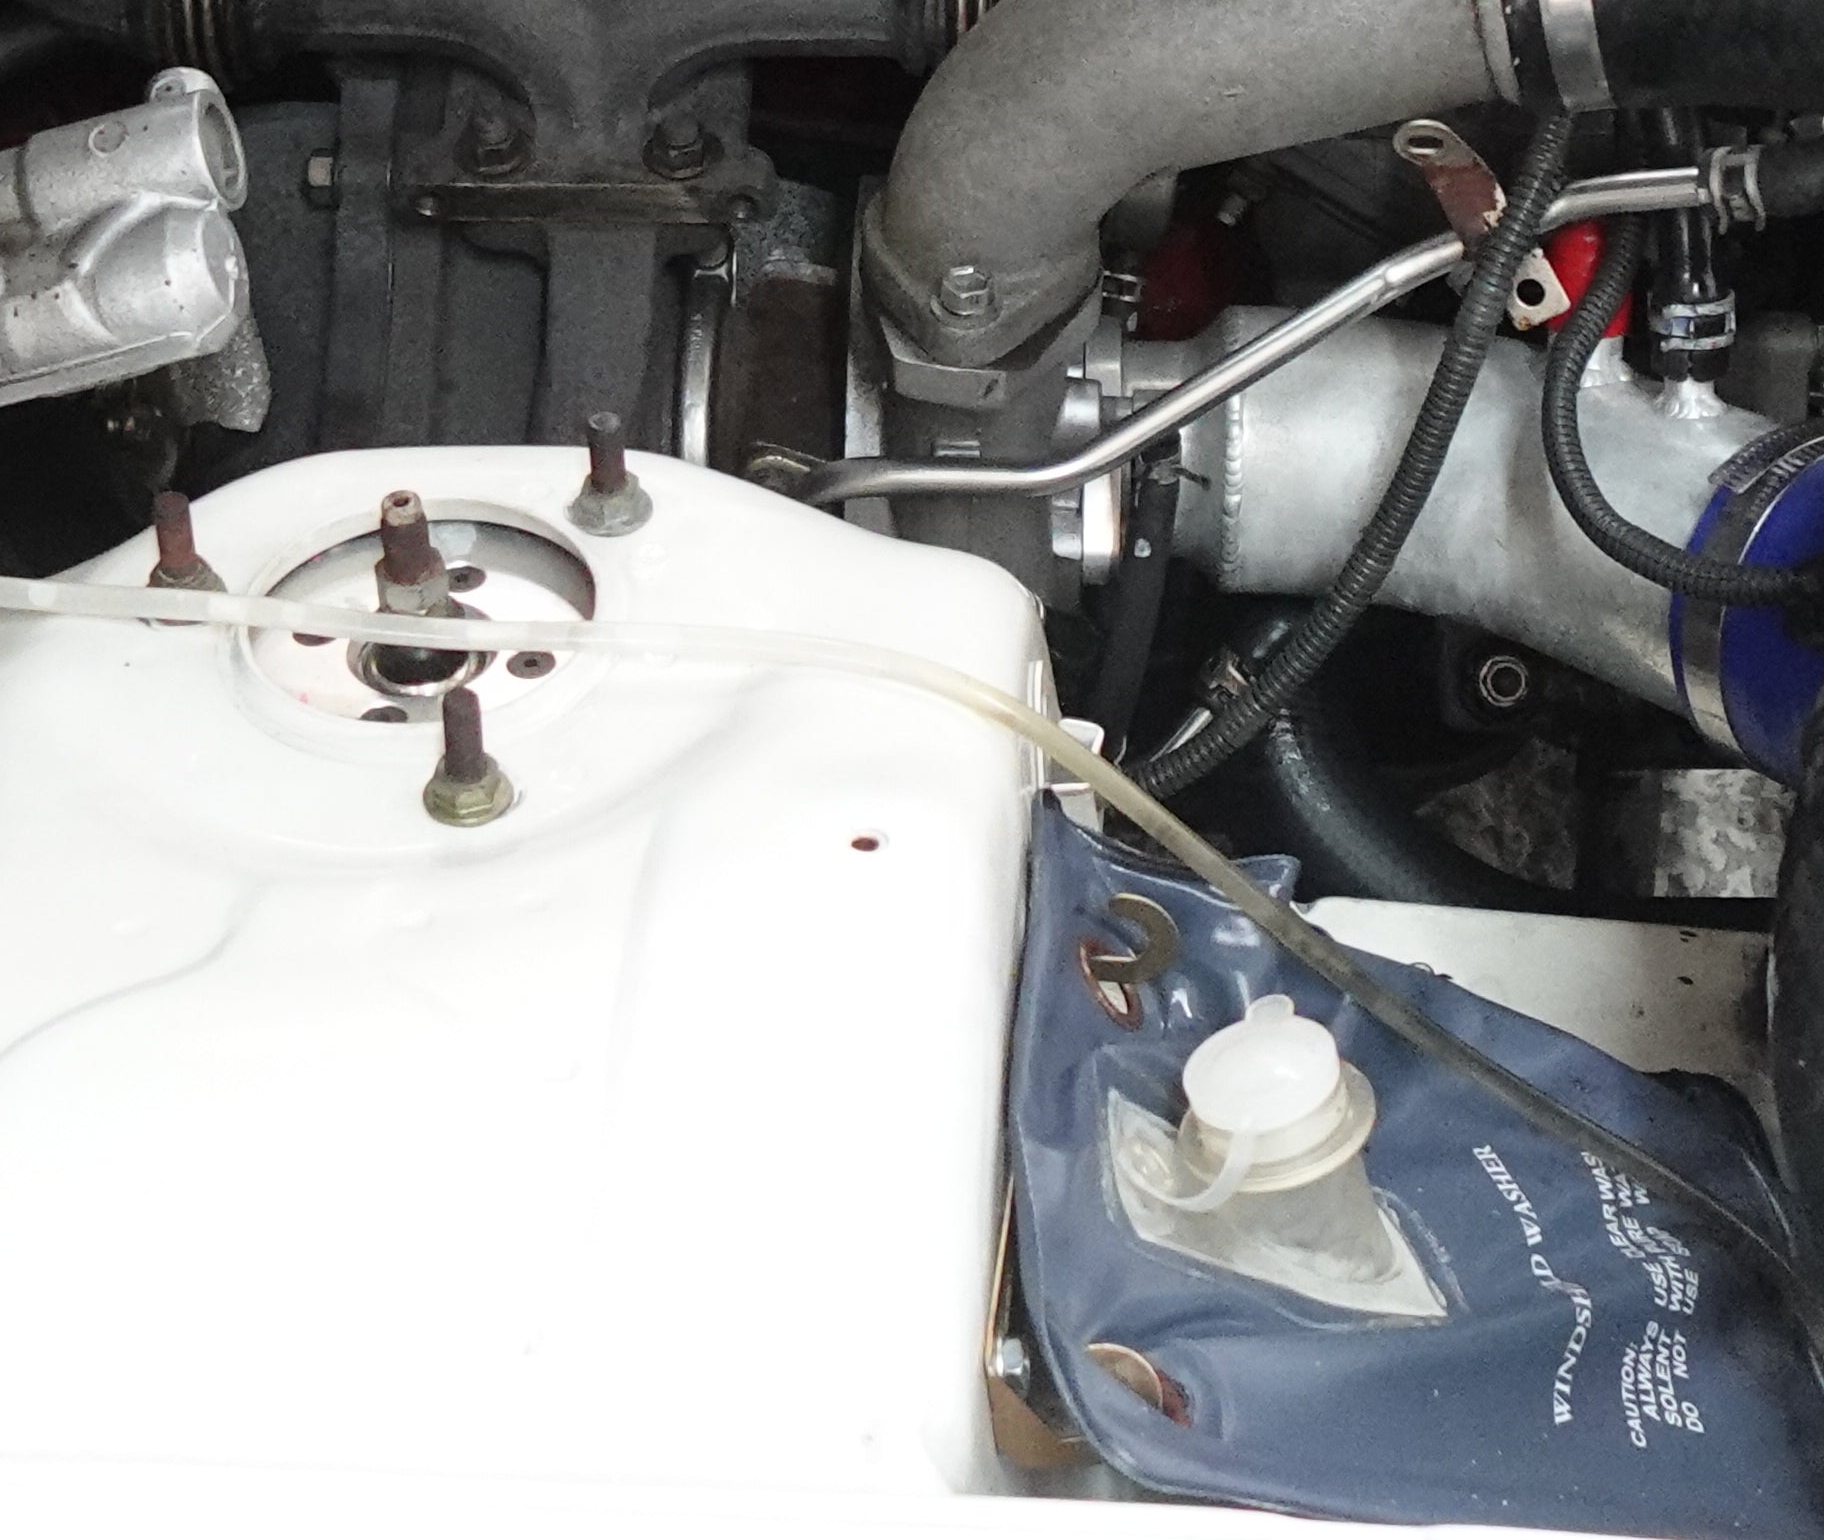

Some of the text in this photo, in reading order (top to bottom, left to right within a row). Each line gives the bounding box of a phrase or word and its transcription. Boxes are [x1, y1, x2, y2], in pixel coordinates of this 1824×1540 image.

[1473, 1144, 1542, 1247] WASHER
[1610, 1166, 1634, 1208] WA
[1631, 1176, 1651, 1205] W
[1642, 1262, 1669, 1307] USE
[1661, 1255, 1681, 1312] WITH
[1682, 1270, 1700, 1316] USE
[1636, 1320, 1661, 1421] ALWAYS
[1655, 1328, 1683, 1428] SOLENT
[1672, 1329, 1690, 1379] NOT
[1682, 1401, 1705, 1434] DO
